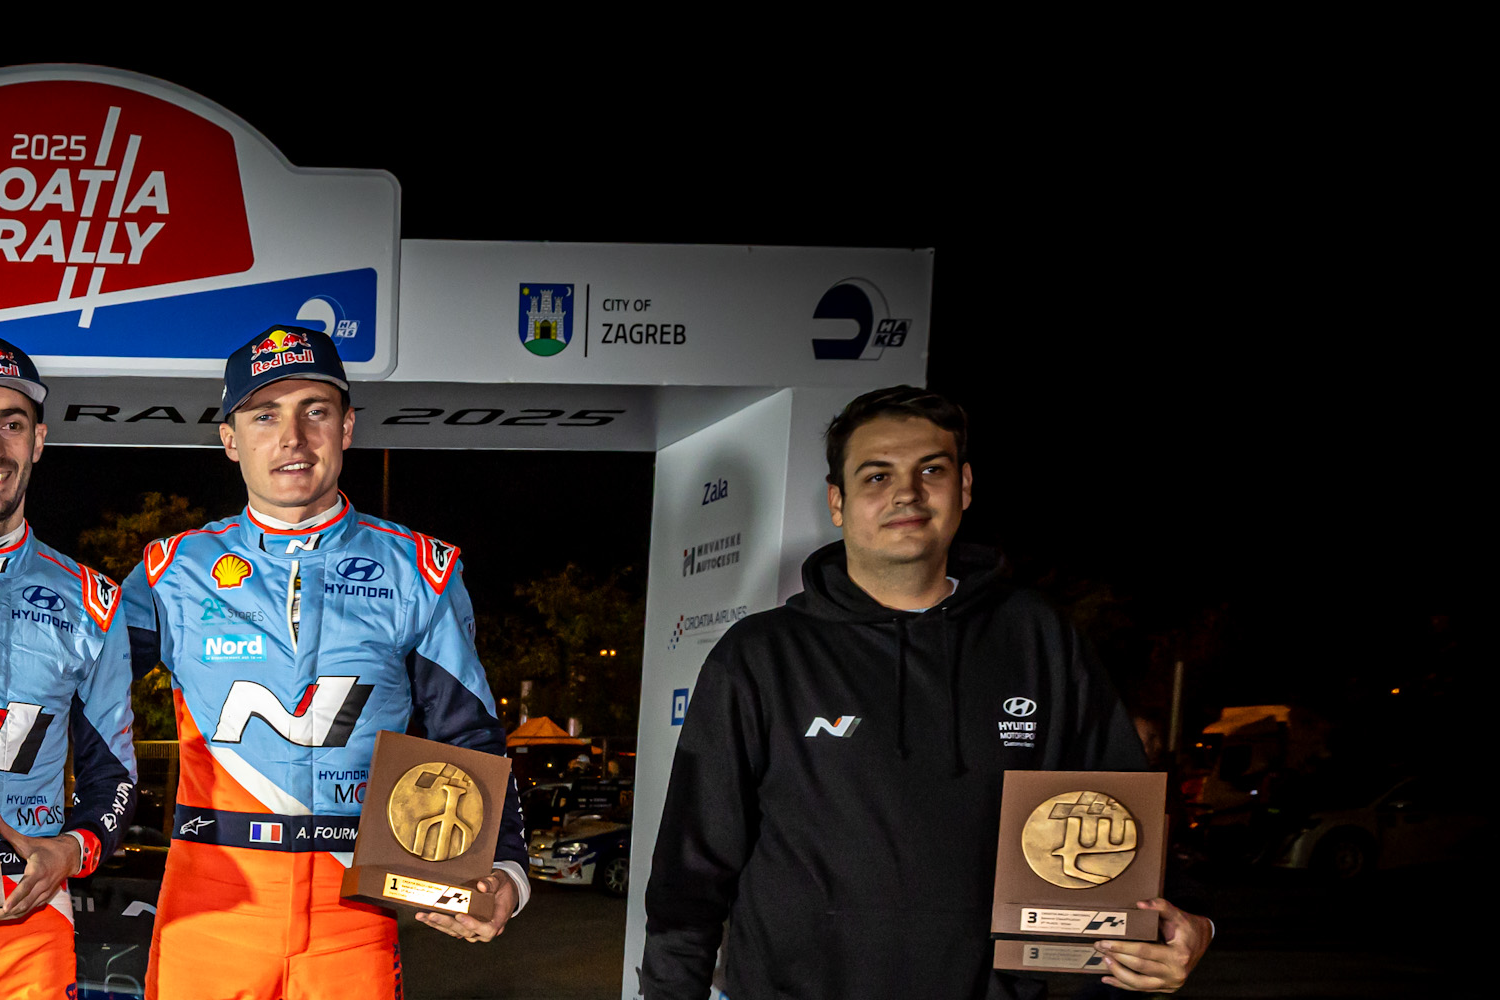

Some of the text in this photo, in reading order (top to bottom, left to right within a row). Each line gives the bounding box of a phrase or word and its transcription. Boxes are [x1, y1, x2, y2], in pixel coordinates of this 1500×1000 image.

[11, 133, 87, 161] 2025
[603, 298, 651, 312] CITY OF
[601, 323, 687, 346] ZAGREB
[252, 348, 314, 377] Red Bull
[381, 407, 626, 427] 2025
[702, 478, 729, 506] Zala
[697, 532, 741, 556] HRVATSKE
[325, 584, 394, 599] HYUNDAI
[11, 608, 74, 634] HYUNDAI
[684, 605, 748, 631] CROATIA AIRLINES
[206, 635, 262, 655] Nord
[7, 794, 47, 806] HYUNDAI
[296, 825, 358, 841] A. FOURM
[390, 878, 397, 890] 1
[1027, 912, 1037, 923] 3
[1030, 948, 1039, 959] 3
